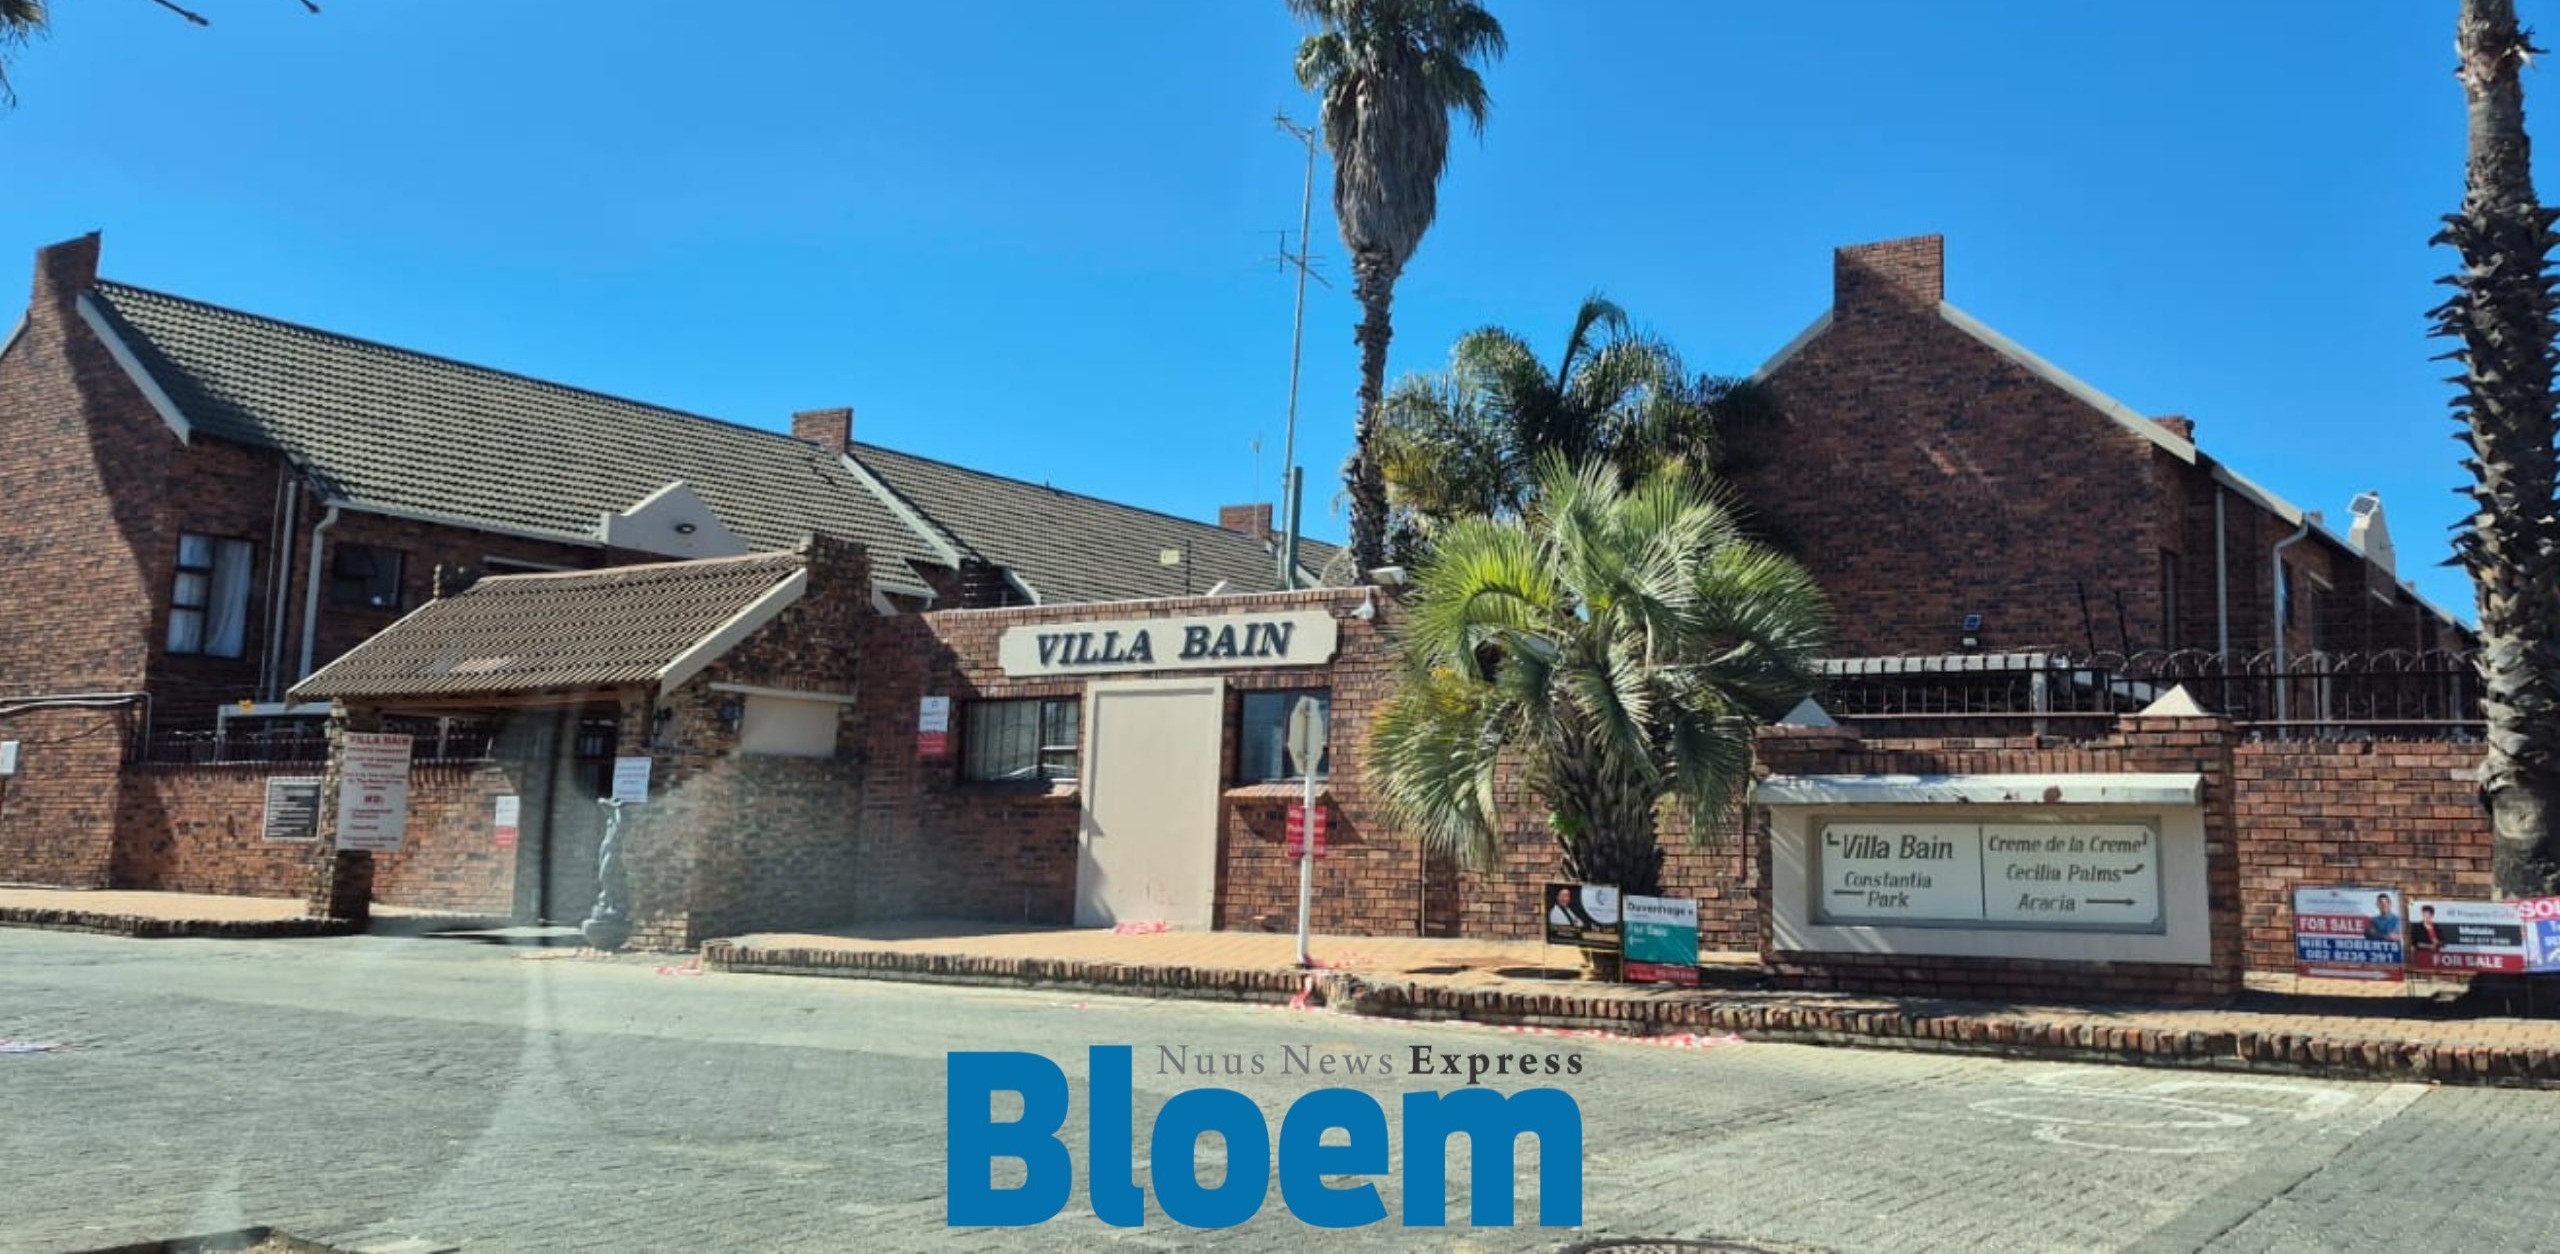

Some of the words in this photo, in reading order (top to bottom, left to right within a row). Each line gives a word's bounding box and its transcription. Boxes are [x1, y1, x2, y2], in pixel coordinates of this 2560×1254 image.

[1036, 629, 1155, 667] VILLA
[1179, 620, 1295, 661] BAIN
[1843, 833, 1890, 860] Villa
[1898, 835, 1953, 860] Bain
[1988, 835, 2041, 852] Creme
[2045, 836, 2065, 852] de
[2069, 836, 2085, 852] la
[2089, 836, 2141, 854] Creme
[1844, 871, 1932, 889] Constantia
[2006, 864, 2062, 882] Cecilia
[2067, 864, 2122, 883] Palms
[1867, 891, 1910, 908] Park
[2018, 893, 2075, 911] Acacia
[2299, 916, 2326, 931] FOR
[2331, 917, 2365, 932] SALE
[2432, 954, 2462, 967] FOR
[2465, 955, 2504, 968] SALE
